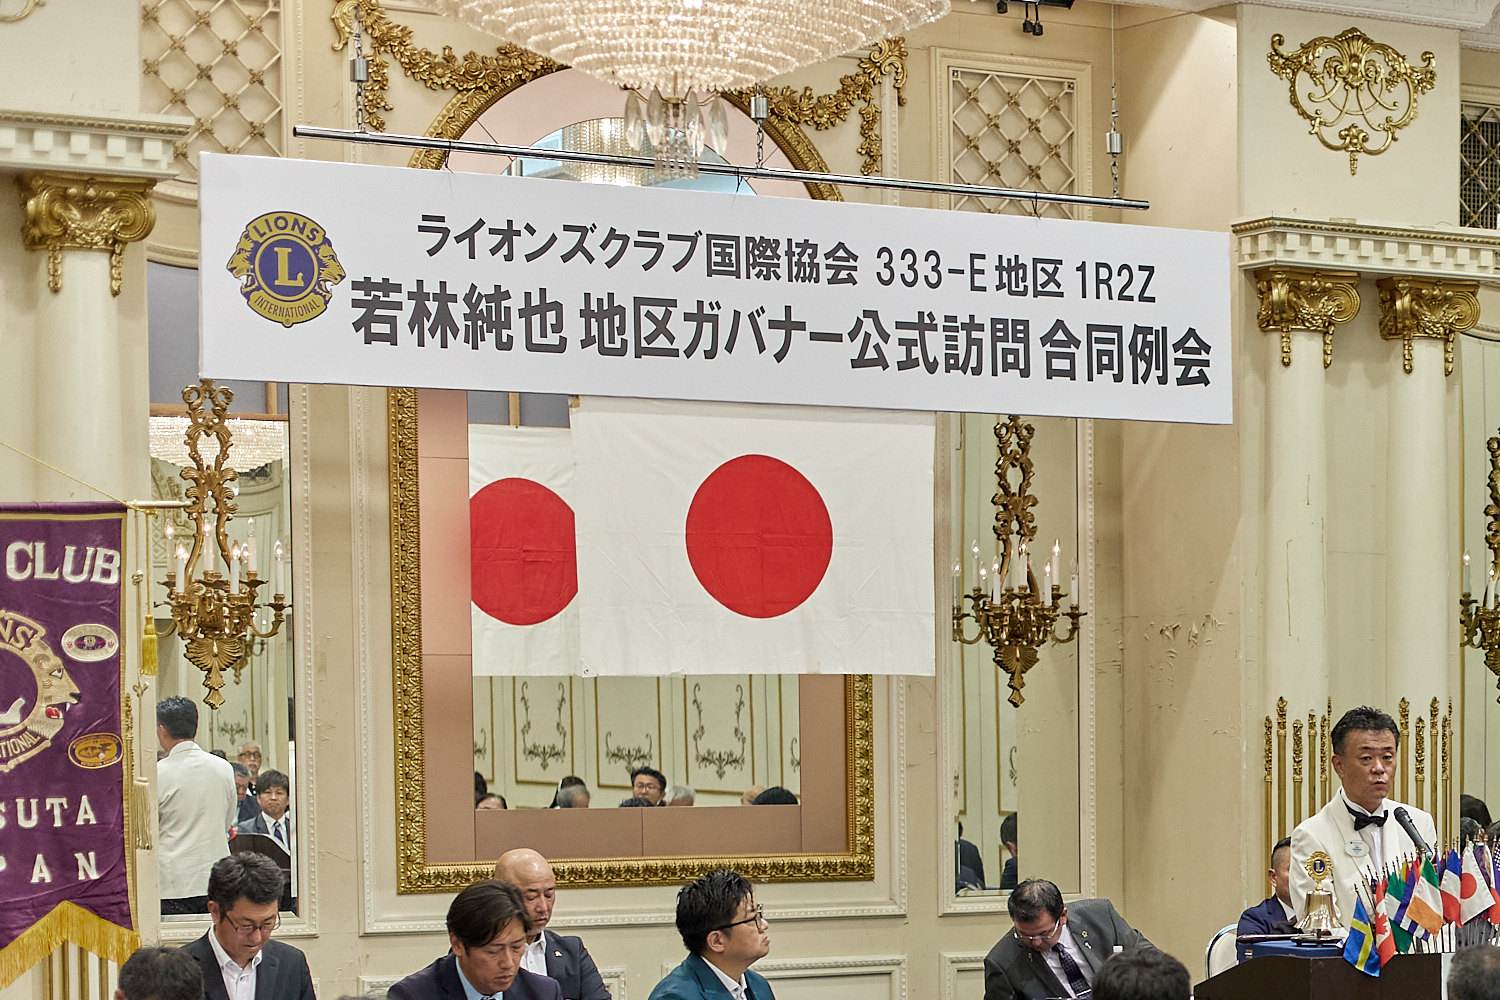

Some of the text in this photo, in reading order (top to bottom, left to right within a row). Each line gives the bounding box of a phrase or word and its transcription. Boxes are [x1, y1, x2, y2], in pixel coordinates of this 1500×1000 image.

[252, 215, 320, 242] LIONS
[273, 246, 305, 287] L
[417, 213, 859, 286] ライオンズクラブ国際協会
[1075, 260, 1156, 303] 1R2Z
[254, 295, 321, 319] INTERNATIONAL
[350, 275, 568, 354] 若林純也
[5, 541, 121, 585] CLUB
